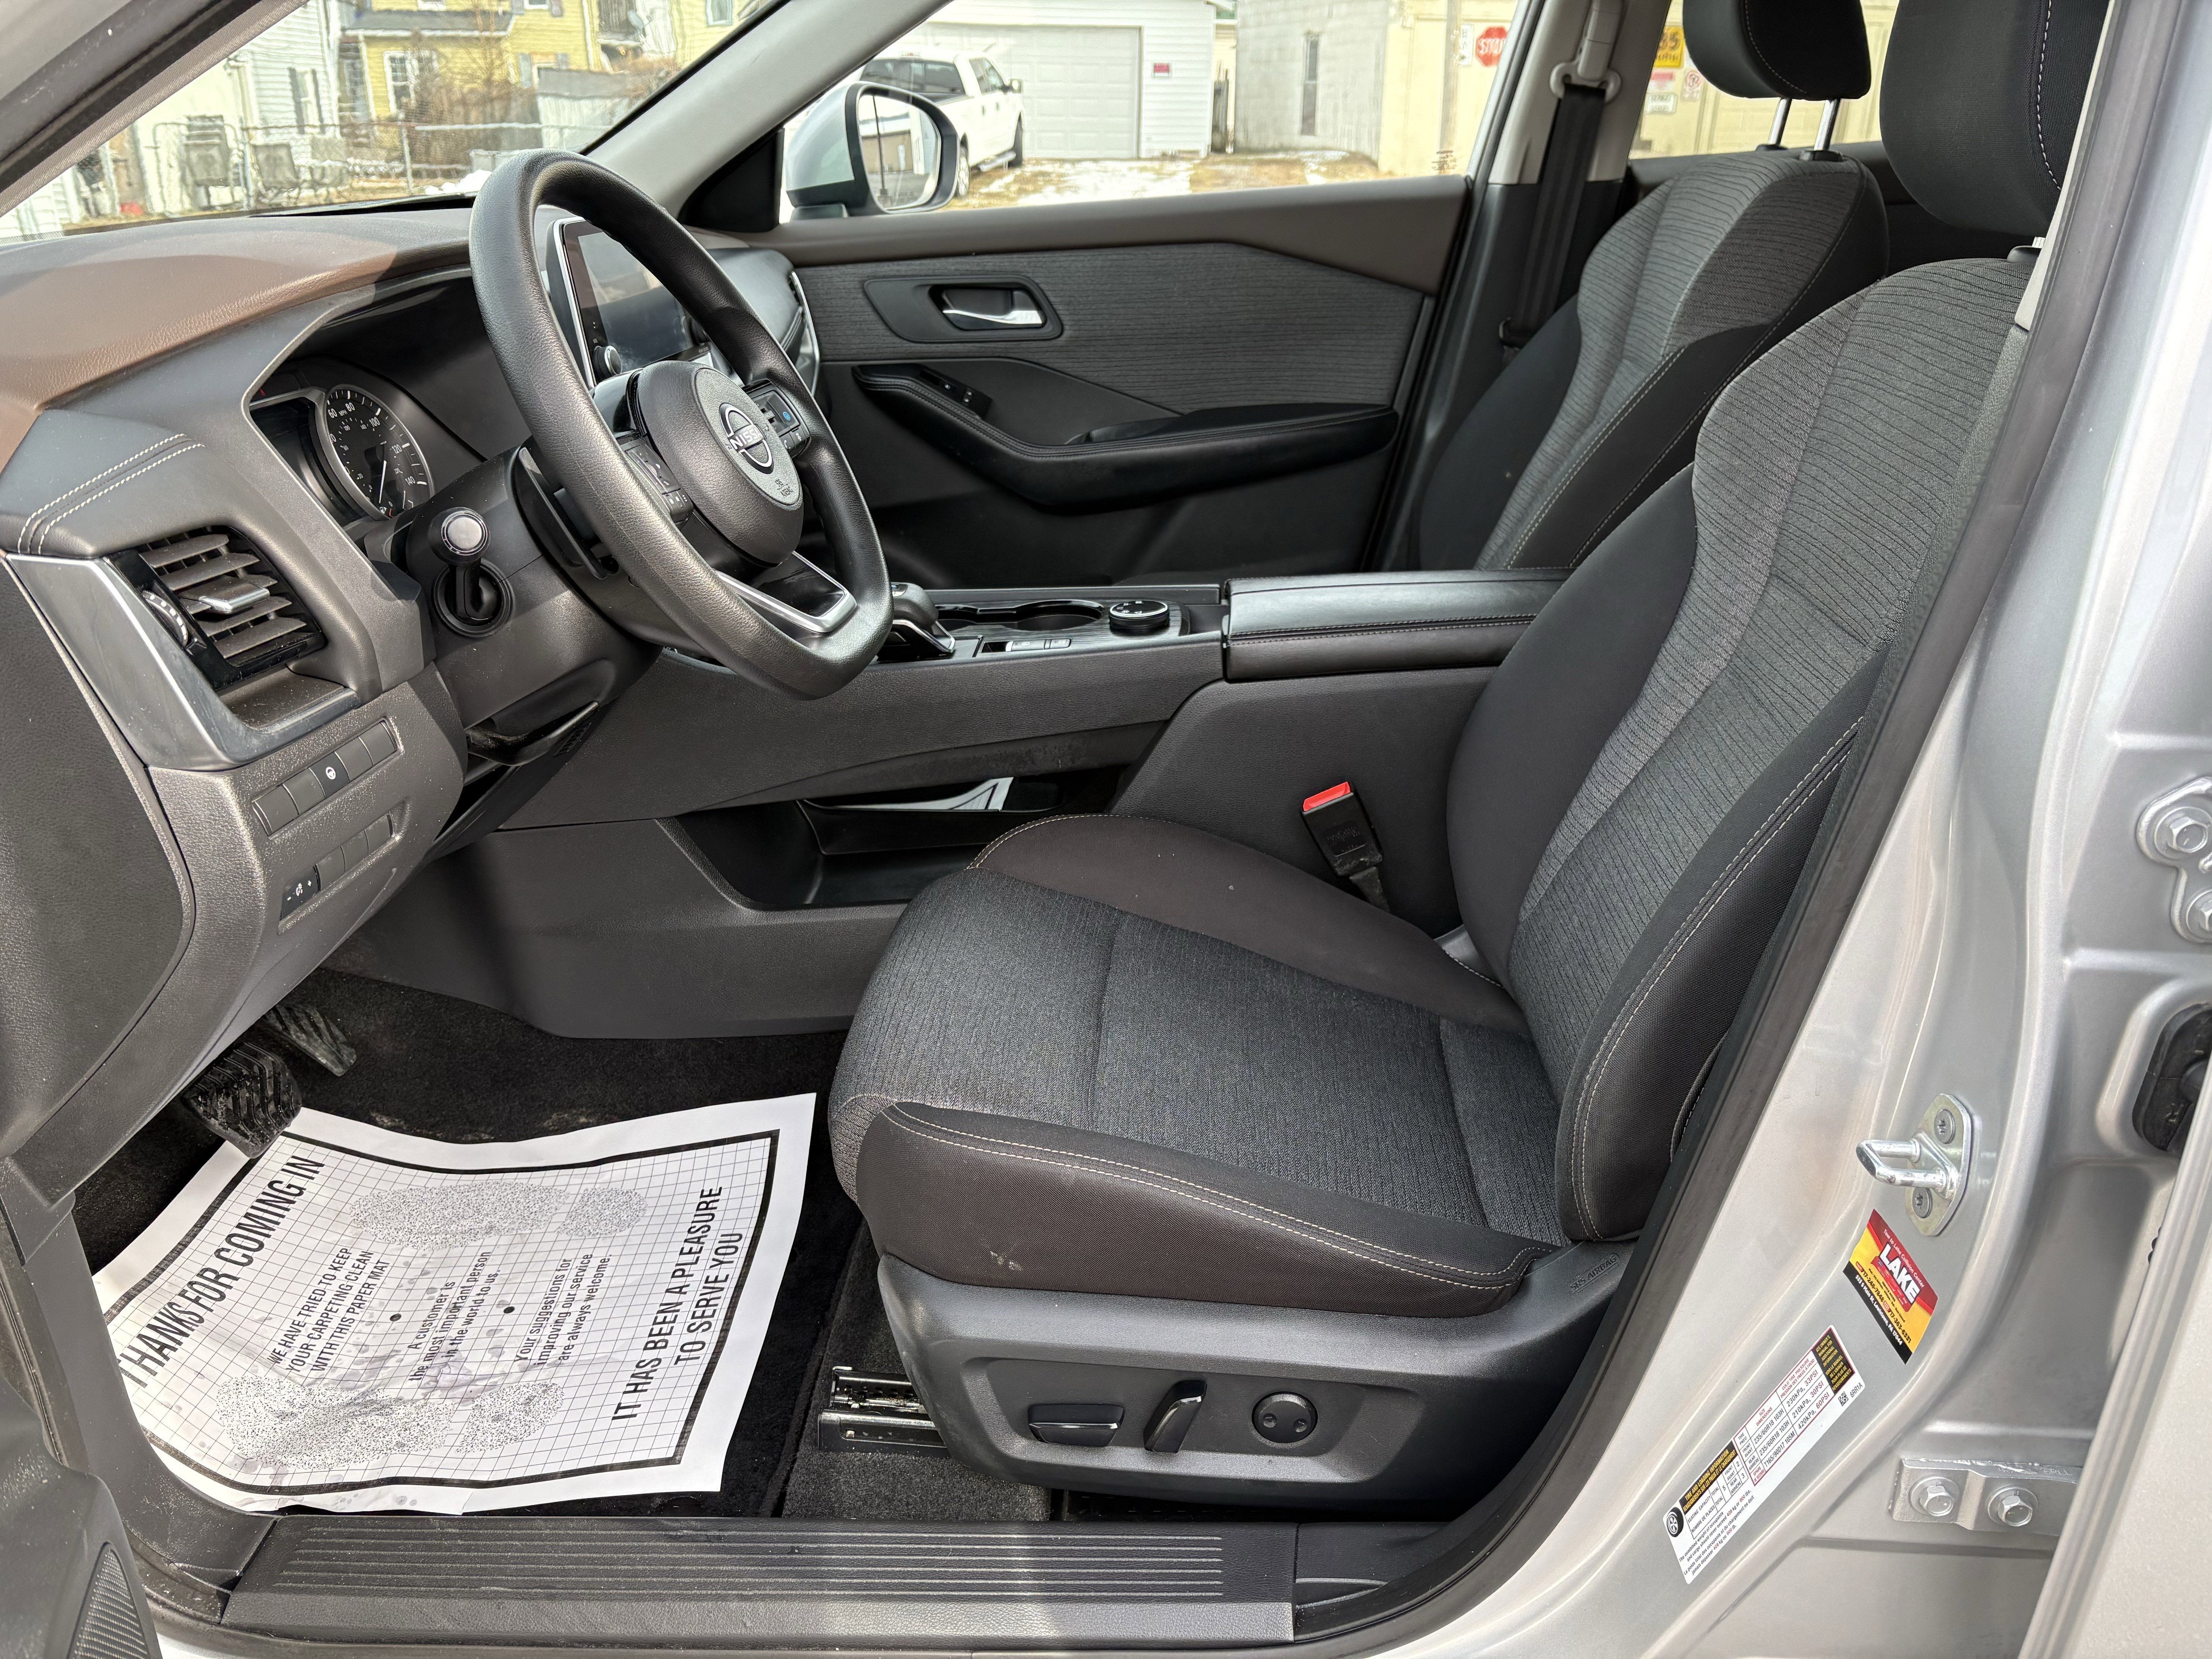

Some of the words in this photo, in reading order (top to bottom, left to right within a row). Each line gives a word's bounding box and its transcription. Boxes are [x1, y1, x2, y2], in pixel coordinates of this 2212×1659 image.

[328, 408, 337, 418] 60
[345, 402, 355, 412] 80
[369, 417, 380, 427] 100
[392, 444, 402, 454] 120
[405, 476, 415, 486] 140
[671, 1186, 723, 1279] PLEASURE
[709, 1233, 743, 1269] YOU
[116, 1301, 205, 1388] THANKS
[178, 1267, 240, 1313] FOR
[214, 1180, 307, 1267] COMING
[282, 1155, 325, 1180] IN
[484, 1269, 501, 1284] us.
[1571, 1277, 1586, 1290] SRS
[1587, 1257, 1617, 1280] AIRBAG
[1879, 1242, 1920, 1305] LAKE
[1889, 1237, 1894, 1246] to
[1893, 1242, 1902, 1256] Lake
[1900, 1253, 1914, 1274] Collision
[1913, 1271, 1925, 1289] Center
[267, 1348, 287, 1364] WE
[278, 1320, 306, 1348] HAVE
[297, 1288, 326, 1317] TRIED
[318, 1273, 337, 1286] TO
[328, 1248, 352, 1271] KEEP
[476, 1286, 491, 1297] to
[558, 1344, 575, 1361] are
[567, 1304, 591, 1341] always
[584, 1254, 612, 1302] welcome.
[665, 1284, 691, 1295] A
[687, 1274, 730, 1334] SERVE
[285, 1343, 316, 1372] YOUR
[307, 1283, 354, 1340] CARPETING
[345, 1250, 374, 1281] CLEAN
[310, 1342, 340, 1371] WITH
[330, 1317, 355, 1339] THIS
[346, 1282, 377, 1315] PAPER
[368, 1259, 390, 1280] MAT
[408, 1365, 429, 1381] the
[422, 1336, 445, 1362] most
[435, 1285, 473, 1333] important
[466, 1251, 491, 1283] person
[416, 1293, 449, 1340] customer
[441, 1281, 455, 1291] is
[461, 1298, 485, 1326] world
[514, 1337, 537, 1362] Your
[529, 1274, 565, 1334] suggestions
[556, 1258, 572, 1272] for
[533, 1312, 572, 1365] improving
[562, 1293, 577, 1309] our
[570, 1254, 593, 1290] service
[643, 1301, 684, 1352] BEEN
[1863, 1285, 1871, 1298] Main
[1887, 1322, 1893, 1333] PA
[1892, 1329, 1903, 1346] 17044
[441, 1348, 459, 1358] in
[449, 1329, 469, 1346] the
[673, 1340, 706, 1366] TO
[622, 1357, 663, 1395] HAS
[1849, 1381, 1863, 1398] 6RR1A
[611, 1402, 642, 1421] IT
[1753, 1419, 1774, 1445] 235/60R18
[1773, 1407, 1784, 1422] 103H
[1786, 1384, 1805, 1408] 230kPa,
[1804, 1369, 1818, 1387] 33PSI
[1759, 1430, 1780, 1456] 235/60R18
[1779, 1419, 1790, 1434] 103H
[1791, 1395, 1811, 1420] 210kPa,
[1810, 1380, 1824, 1398] 30PSI
[1764, 1441, 1785, 1468] T165/90D17
[1784, 1430, 1795, 1445] 105M
[1797, 1406, 1817, 1431] 420kPa,
[1815, 1391, 1830, 1410] 60PSI
[1697, 1469, 1711, 1487] LOADING
[1709, 1448, 1729, 1474] INFORMATION
[1687, 1508, 1698, 1523] SEATING
[1698, 1494, 1711, 1511] CAPACITY
[1711, 1486, 1719, 1496] TOTAL
[1705, 1504, 1715, 1518] PLACES
